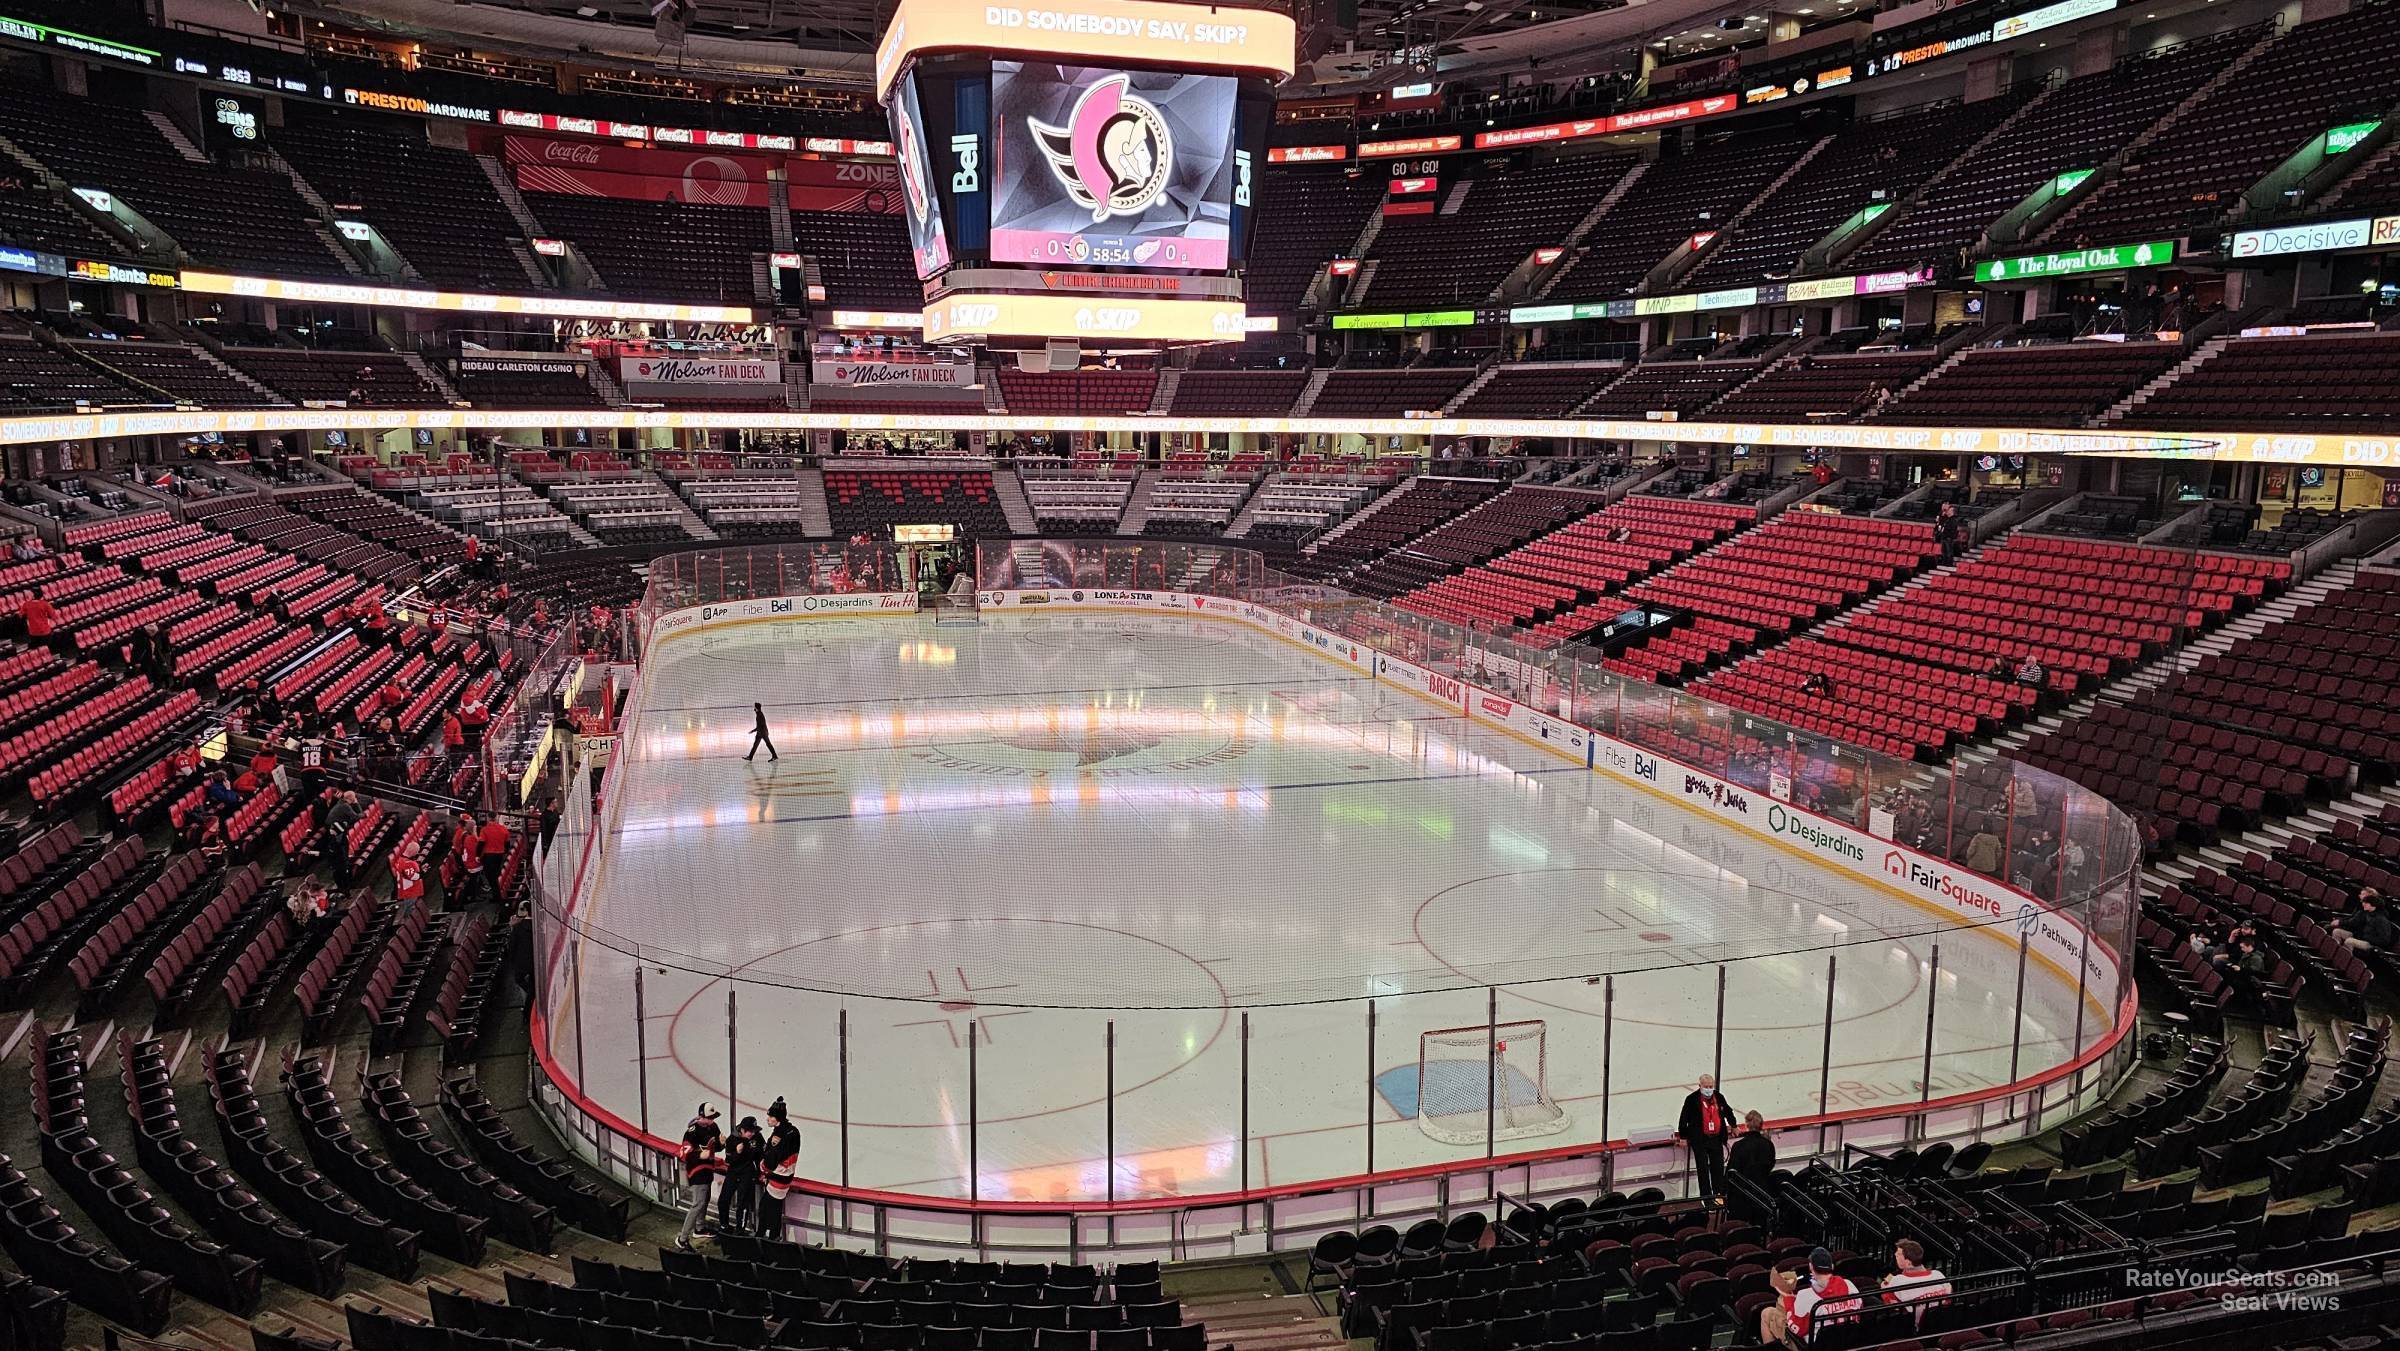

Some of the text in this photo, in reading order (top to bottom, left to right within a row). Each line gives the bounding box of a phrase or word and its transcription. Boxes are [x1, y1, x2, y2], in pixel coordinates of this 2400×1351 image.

[986, 6, 1247, 45] DID SOMEBODY SAY, SKIP?
[216, 98, 239, 112] GO
[217, 111, 255, 127] SENS
[1616, 117, 1633, 127] Find
[233, 125, 256, 139] GO
[1486, 134, 1502, 143] Find
[545, 141, 600, 164] Coca-Cola
[1285, 147, 1334, 161] Tim Hortons
[952, 134, 978, 192] Bell
[1392, 160, 1439, 175] GO GO!
[836, 164, 896, 182] ZONE
[1236, 149, 1251, 207] Bell
[2263, 223, 2359, 252] Decisive
[1047, 240, 1058, 256] 0
[1093, 248, 1130, 263] 58:54
[1165, 245, 1176, 260] 0
[2018, 248, 2119, 275] The Royal Oak
[1703, 291, 1749, 305] TechInsights
[1788, 284, 1819, 299] RE/MAX
[1645, 297, 1671, 313] MNP
[1096, 308, 1140, 330] SKIP
[462, 361, 573, 373] RIDEAU CARLETON CASINO
[653, 361, 765, 382] Molson FAN DECK
[850, 365, 955, 383] Molson FAN DECK
[265, 416, 282, 428] DID
[284, 415, 347, 427] SOMEBODY
[2, 420, 51, 440] SOMEBODY
[1631, 425, 1679, 437] SOMEBODY
[1774, 428, 1932, 447] DID SOMEBODY SAY, SKIP?
[1999, 433, 2027, 450] DID
[2272, 438, 2316, 460] SKIP
[2343, 441, 2388, 463] DID
[2050, 467, 2062, 475] 116
[820, 597, 873, 610] Desjardins
[880, 595, 896, 608] Tim
[1130, 593, 1153, 601] STAR
[743, 604, 763, 616] Fibe
[771, 600, 793, 613] Bell
[432, 613, 445, 625] 53
[1429, 673, 1460, 703] BRICK
[302, 751, 321, 767] 18
[1605, 746, 1657, 782] Fibe Bell
[1685, 774, 1748, 814] Booster Juice
[1790, 816, 1864, 862] Desjardins
[1911, 863, 2001, 917] FairSquare
[2041, 922, 2078, 960] Pathways
